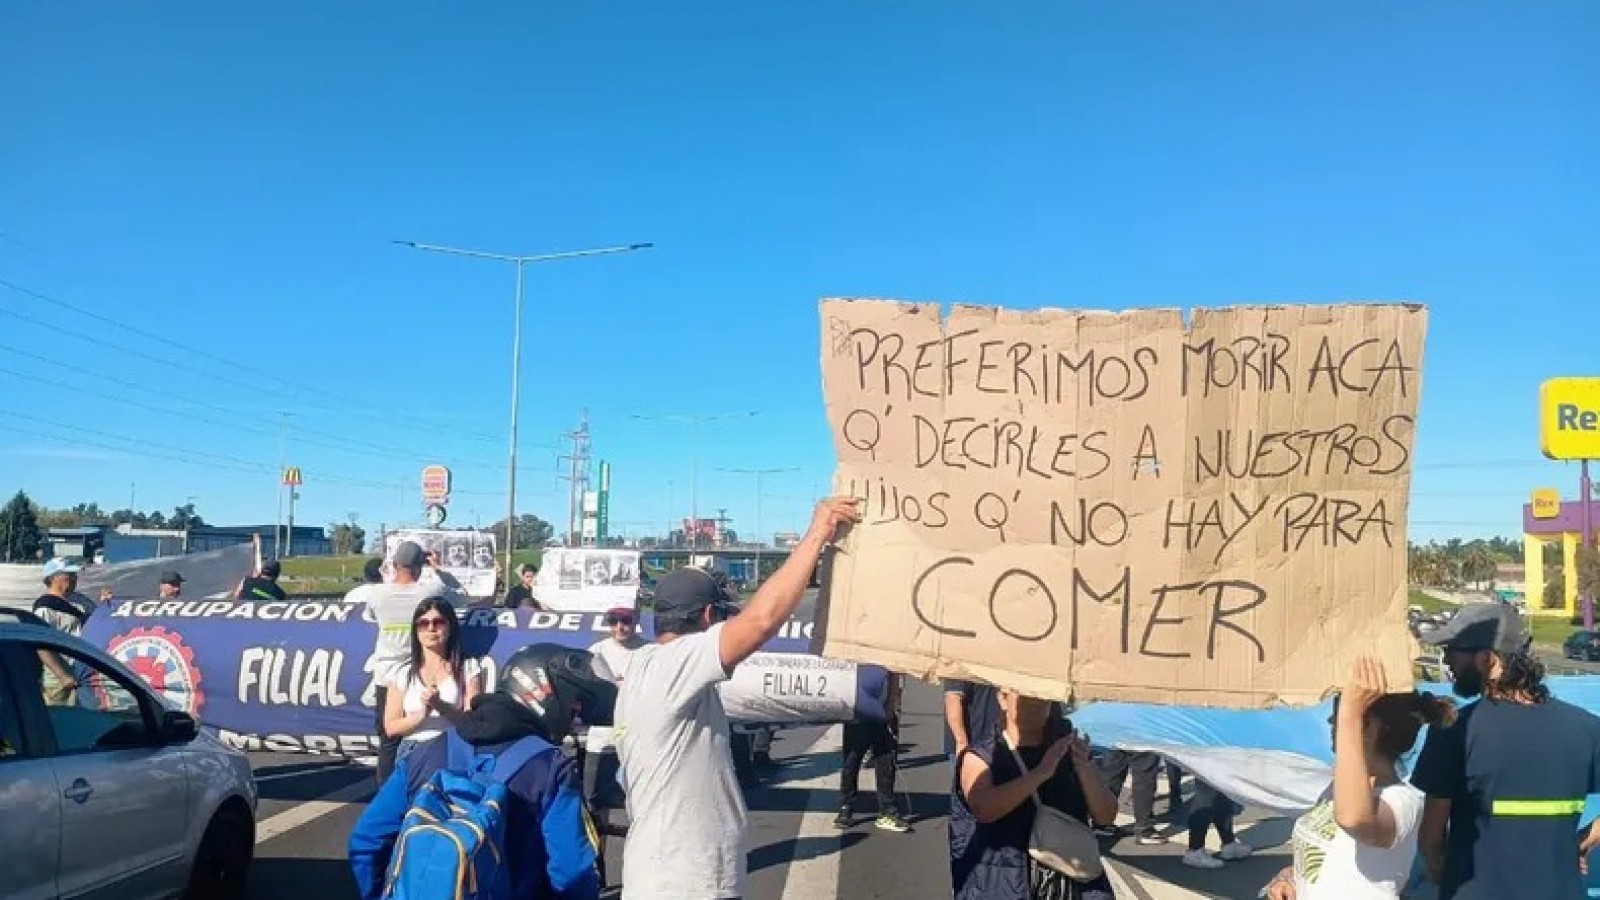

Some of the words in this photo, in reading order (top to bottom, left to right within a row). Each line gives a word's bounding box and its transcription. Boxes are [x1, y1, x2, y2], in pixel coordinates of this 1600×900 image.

[1308, 336, 1416, 398] ACA
[1557, 403, 1600, 431] Re
[1131, 423, 1163, 481] A
[1194, 415, 1414, 483] NUESTROS
[1050, 498, 1130, 547] NO
[1163, 493, 1271, 565] HAY
[1274, 493, 1395, 552] PARA
[528, 613, 584, 631] DE
[912, 556, 1267, 663] COMER
[238, 646, 347, 706] FILIAL
[763, 673, 813, 696] FILIAL
[818, 675, 827, 697] 2
